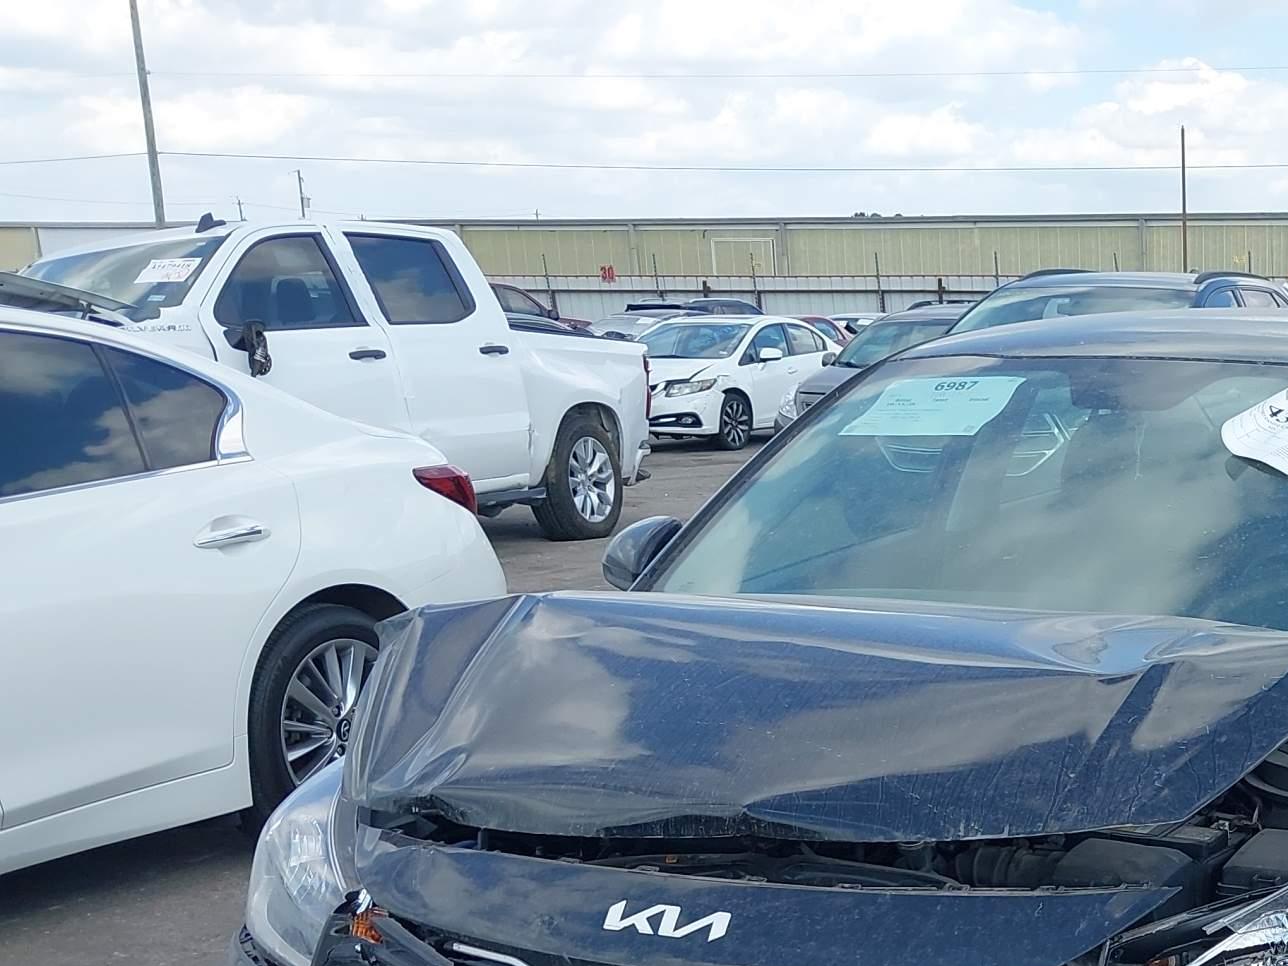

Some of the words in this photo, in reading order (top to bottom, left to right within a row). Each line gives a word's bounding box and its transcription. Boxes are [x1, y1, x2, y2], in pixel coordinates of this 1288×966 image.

[600, 265, 614, 281] 30
[934, 381, 979, 392] 6987
[603, 900, 732, 942] KIA
